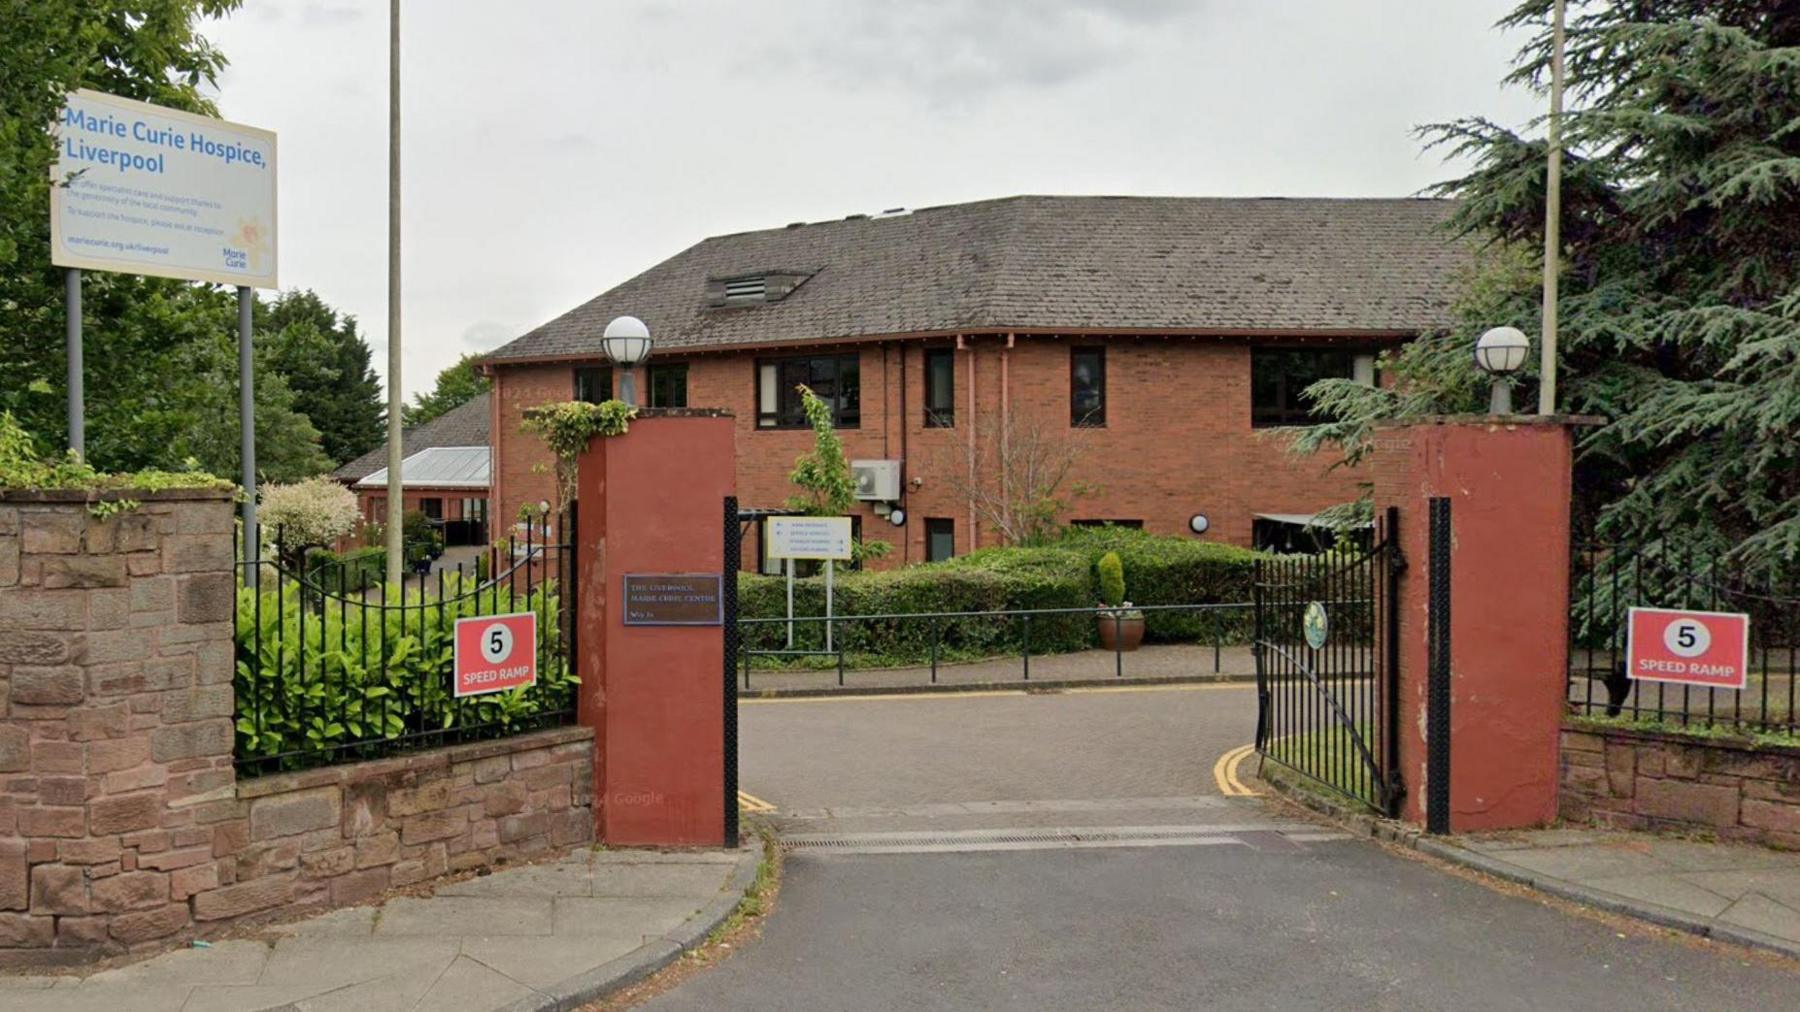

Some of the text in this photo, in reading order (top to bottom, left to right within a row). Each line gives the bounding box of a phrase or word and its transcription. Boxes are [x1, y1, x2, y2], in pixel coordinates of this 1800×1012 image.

[65, 107, 266, 169] Marie Curie Hospice,
[65, 137, 164, 174] Liverpool
[223, 247, 246, 259] Marie
[225, 258, 246, 270] Curie
[631, 584, 648, 592] THE
[490, 630, 503, 655] 5
[1677, 625, 1696, 648] 5
[463, 665, 529, 686] SPEED RAMP
[1639, 658, 1735, 677] SPEED RAMP
